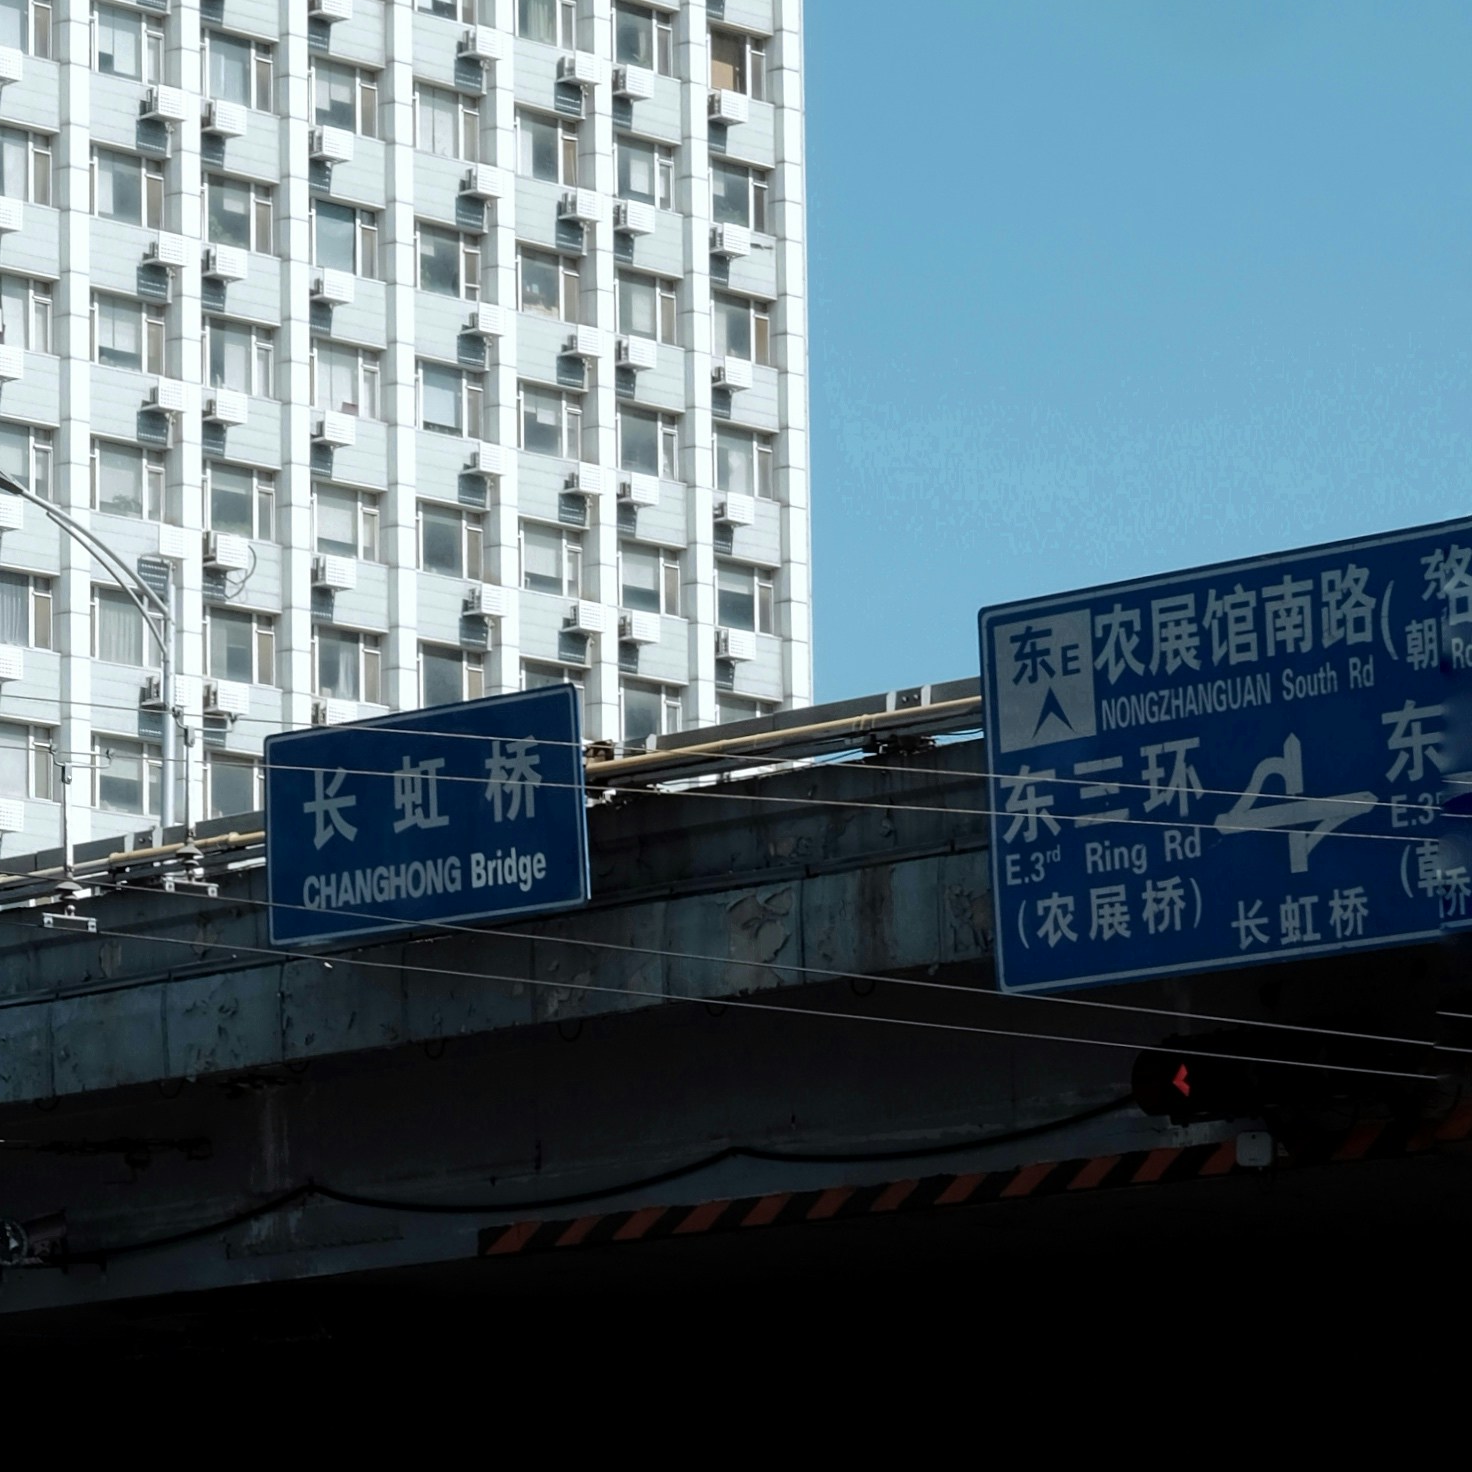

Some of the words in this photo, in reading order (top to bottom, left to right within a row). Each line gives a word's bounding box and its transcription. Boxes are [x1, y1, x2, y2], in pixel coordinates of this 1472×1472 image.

[1061, 644, 1080, 677] E
[1101, 675, 1272, 731] NONGZHANGUAN
[1282, 668, 1338, 702] South
[1349, 656, 1375, 690] Rd
[303, 734, 542, 851] 长虹桥
[1001, 736, 1204, 845] 东三环
[303, 856, 462, 910] CHANGHONG
[471, 847, 546, 892] Bridge
[1006, 845, 1061, 886] E.3rd
[1085, 840, 1147, 875] Ring
[1165, 827, 1202, 863] Rd
[1017, 875, 1203, 950] (农展桥)
[1232, 886, 1369, 952] 长虹桥
